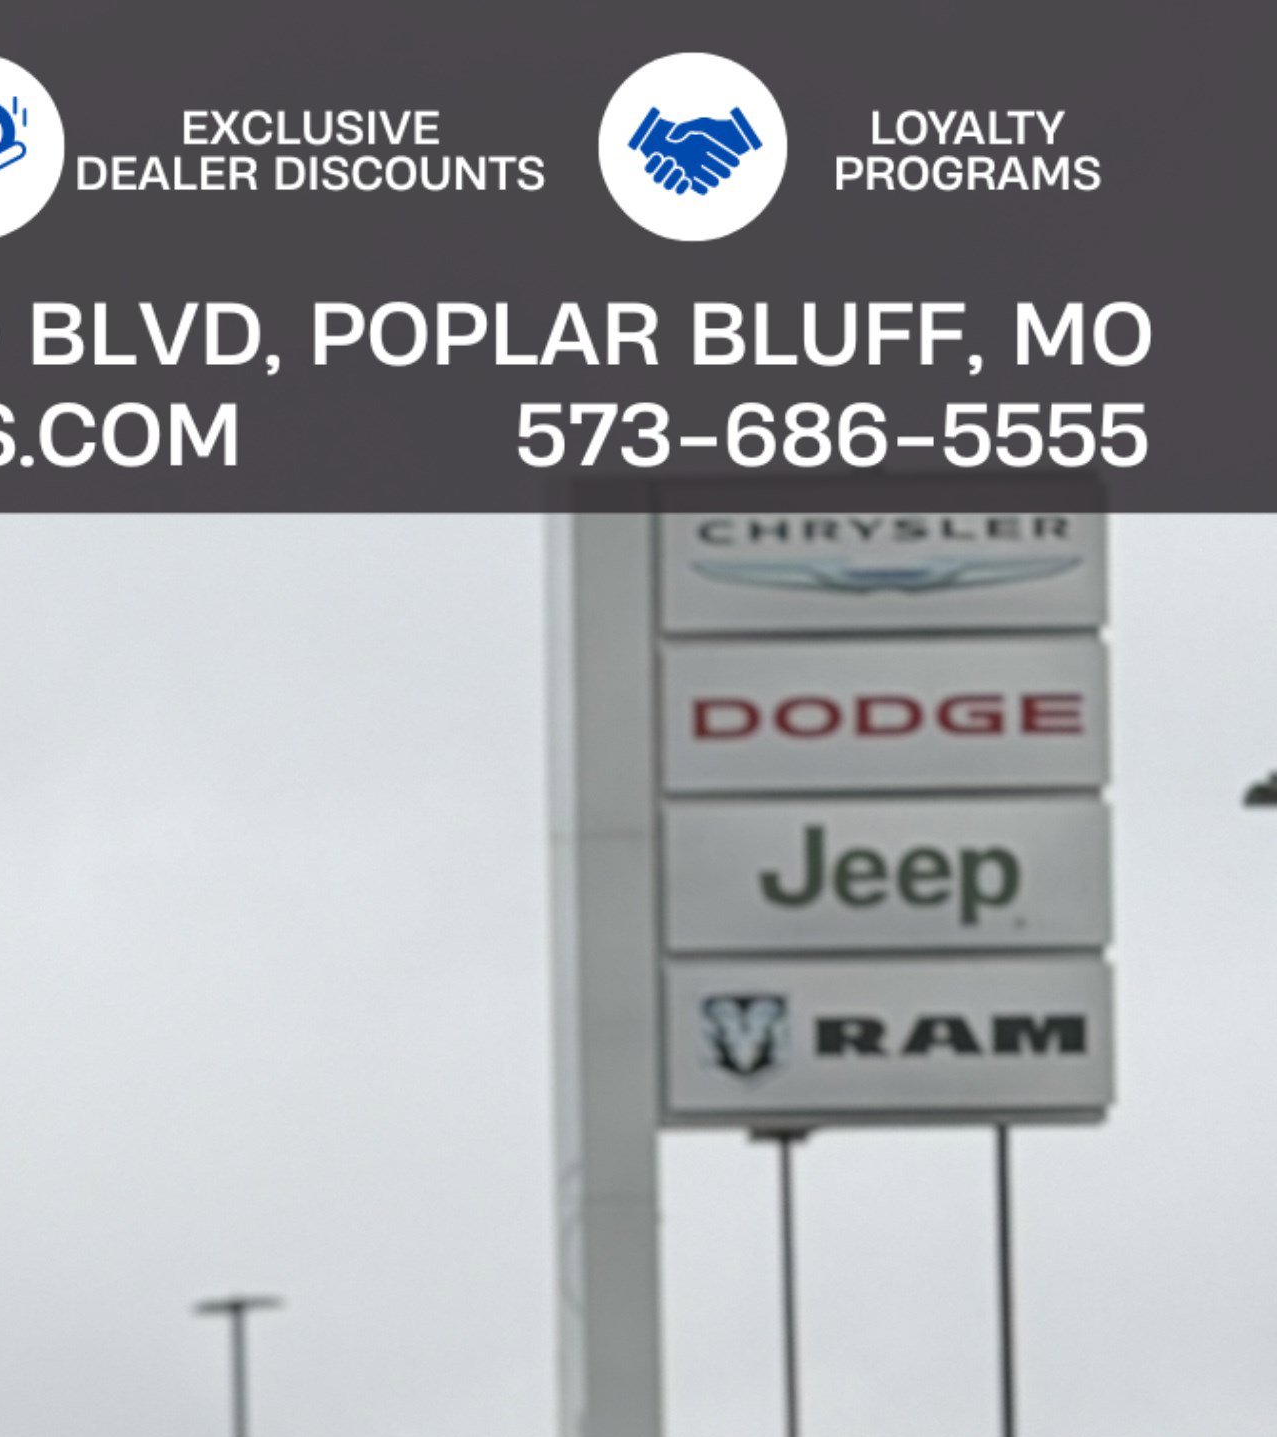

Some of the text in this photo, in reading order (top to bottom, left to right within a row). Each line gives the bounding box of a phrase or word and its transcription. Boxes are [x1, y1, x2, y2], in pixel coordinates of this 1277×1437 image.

[698, 515, 1069, 546] CHRYSLER
[692, 692, 1084, 740] DODGE
[758, 824, 1022, 927] Jeep
[814, 1014, 1088, 1057] RAM
